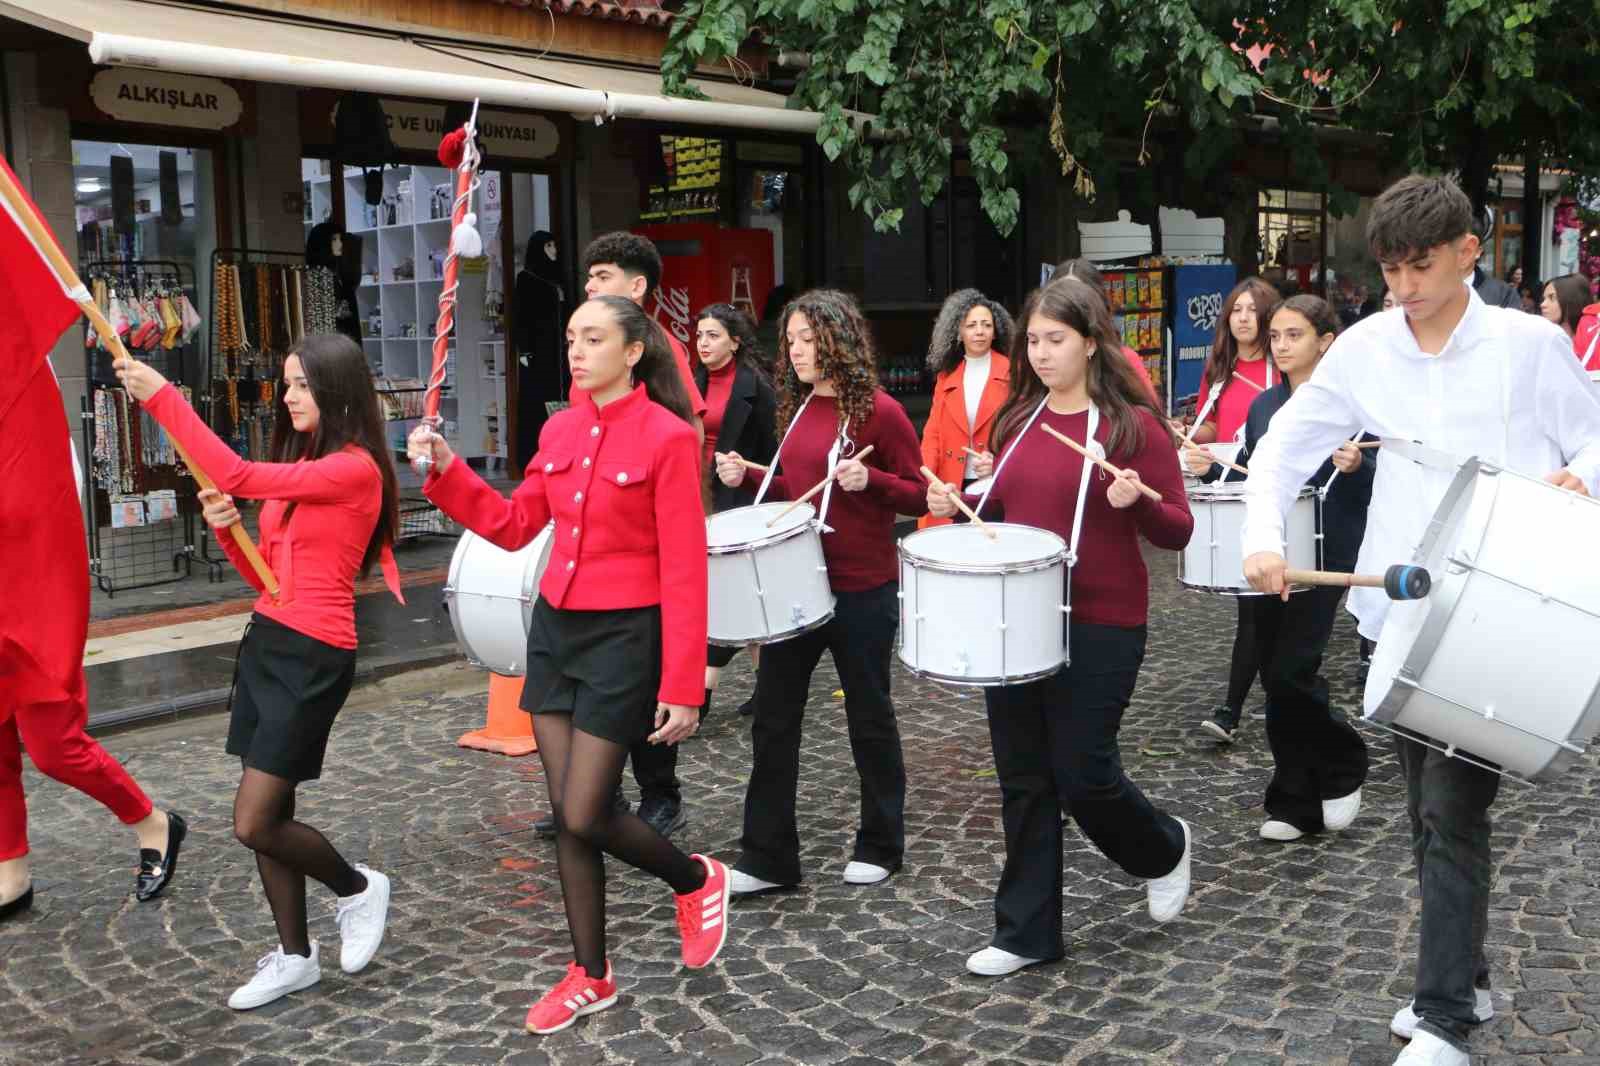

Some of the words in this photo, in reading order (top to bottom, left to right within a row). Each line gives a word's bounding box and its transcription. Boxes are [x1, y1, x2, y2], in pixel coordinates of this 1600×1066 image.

[117, 84, 218, 110] ALKIŞLAR
[400, 116, 420, 131] VE
[480, 120, 536, 142] ÜNYASI
[654, 286, 690, 358] ola
